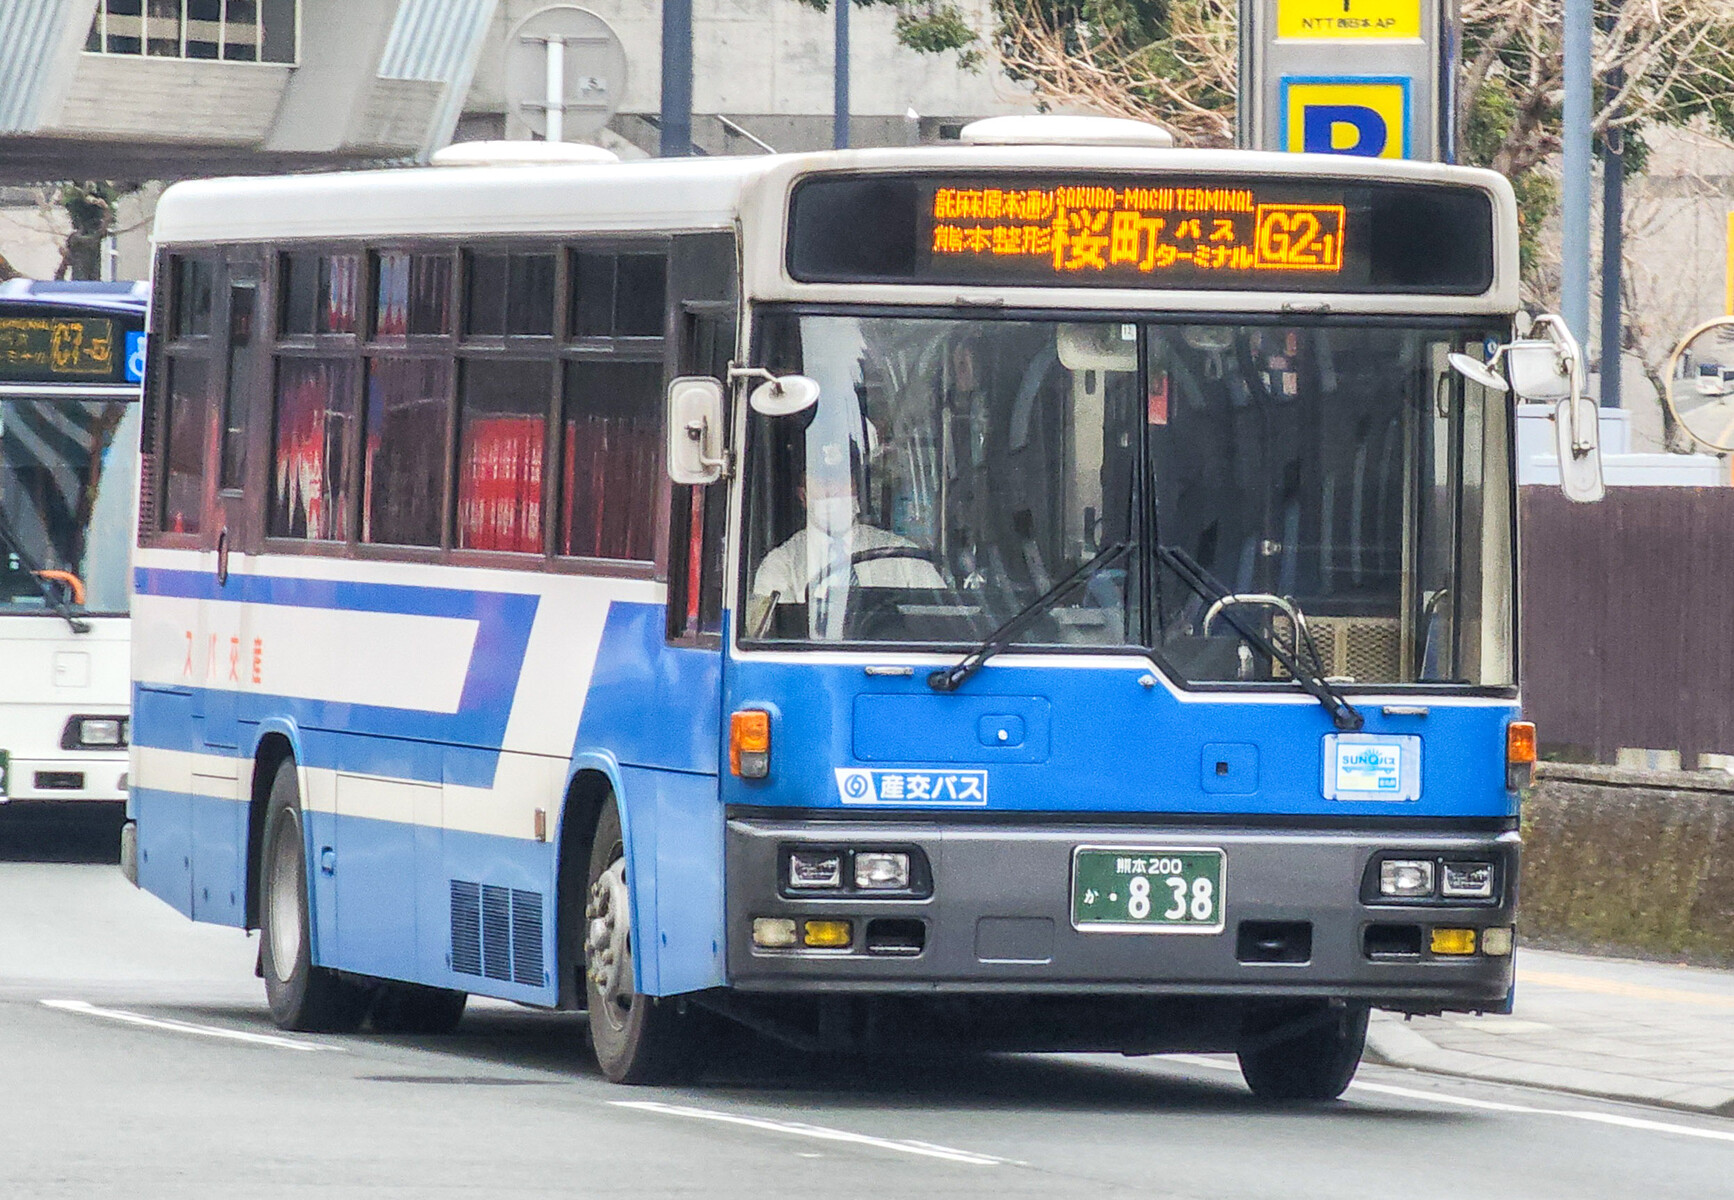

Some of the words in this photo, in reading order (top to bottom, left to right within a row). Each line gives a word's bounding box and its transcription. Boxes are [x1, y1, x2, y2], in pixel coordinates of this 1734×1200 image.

[1056, 186, 1174, 211] SAKURA-MACHI
[1176, 187, 1255, 212] TERMINAL
[932, 224, 1052, 254] 熊本整形
[1051, 206, 1166, 272] 桜町
[1174, 218, 1236, 242] バス
[1263, 211, 1334, 264] G2-1
[1155, 243, 1255, 269] ターミナル
[880, 775, 982, 800] 産交バス
